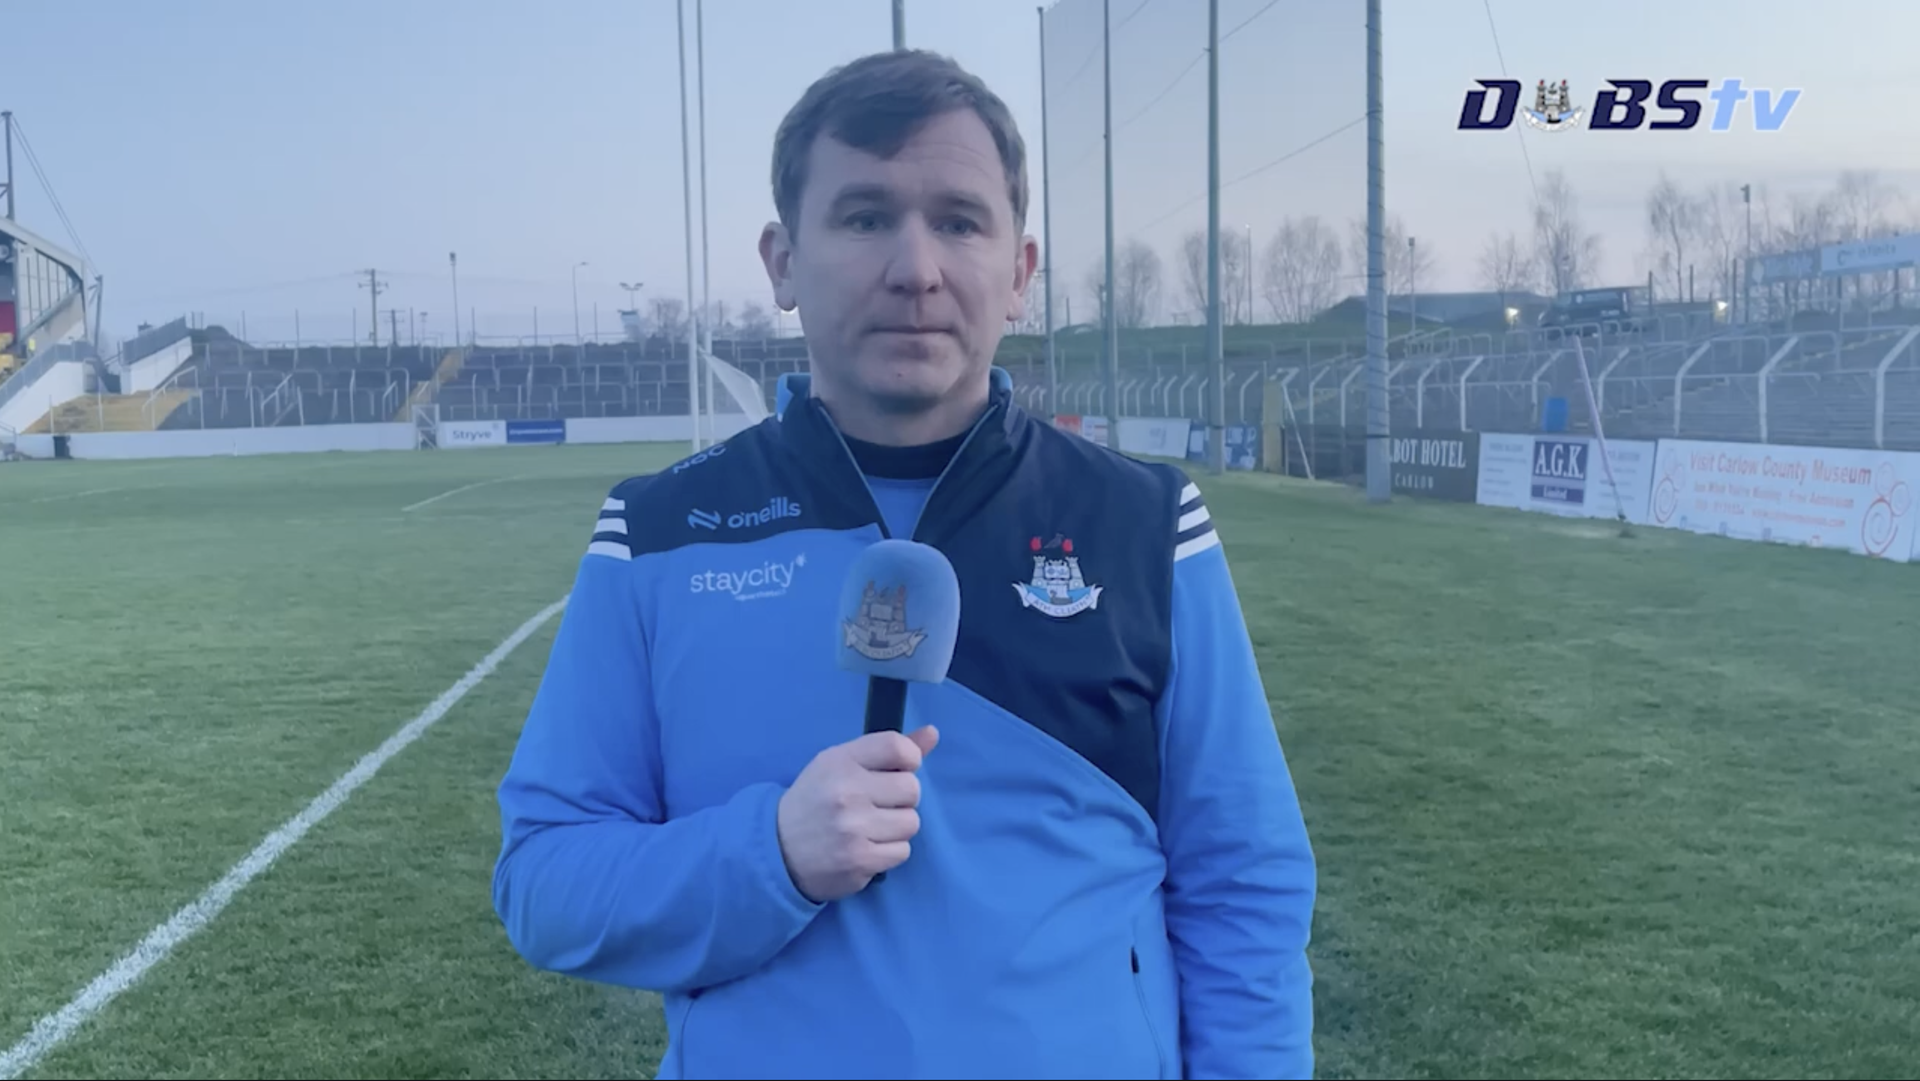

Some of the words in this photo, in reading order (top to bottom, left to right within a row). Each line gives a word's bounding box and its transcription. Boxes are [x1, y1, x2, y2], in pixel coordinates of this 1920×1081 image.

[452, 430, 492, 442] Stryve
[1420, 439, 1467, 468] HOTEL
[1535, 443, 1584, 479] A.G.K.
[1690, 451, 1715, 472] Visit
[1717, 453, 1758, 475] Carlow
[1762, 456, 1807, 486] County
[1811, 459, 1872, 485] Museum
[1394, 473, 1434, 490] CARLOW
[690, 561, 794, 595] staycity
